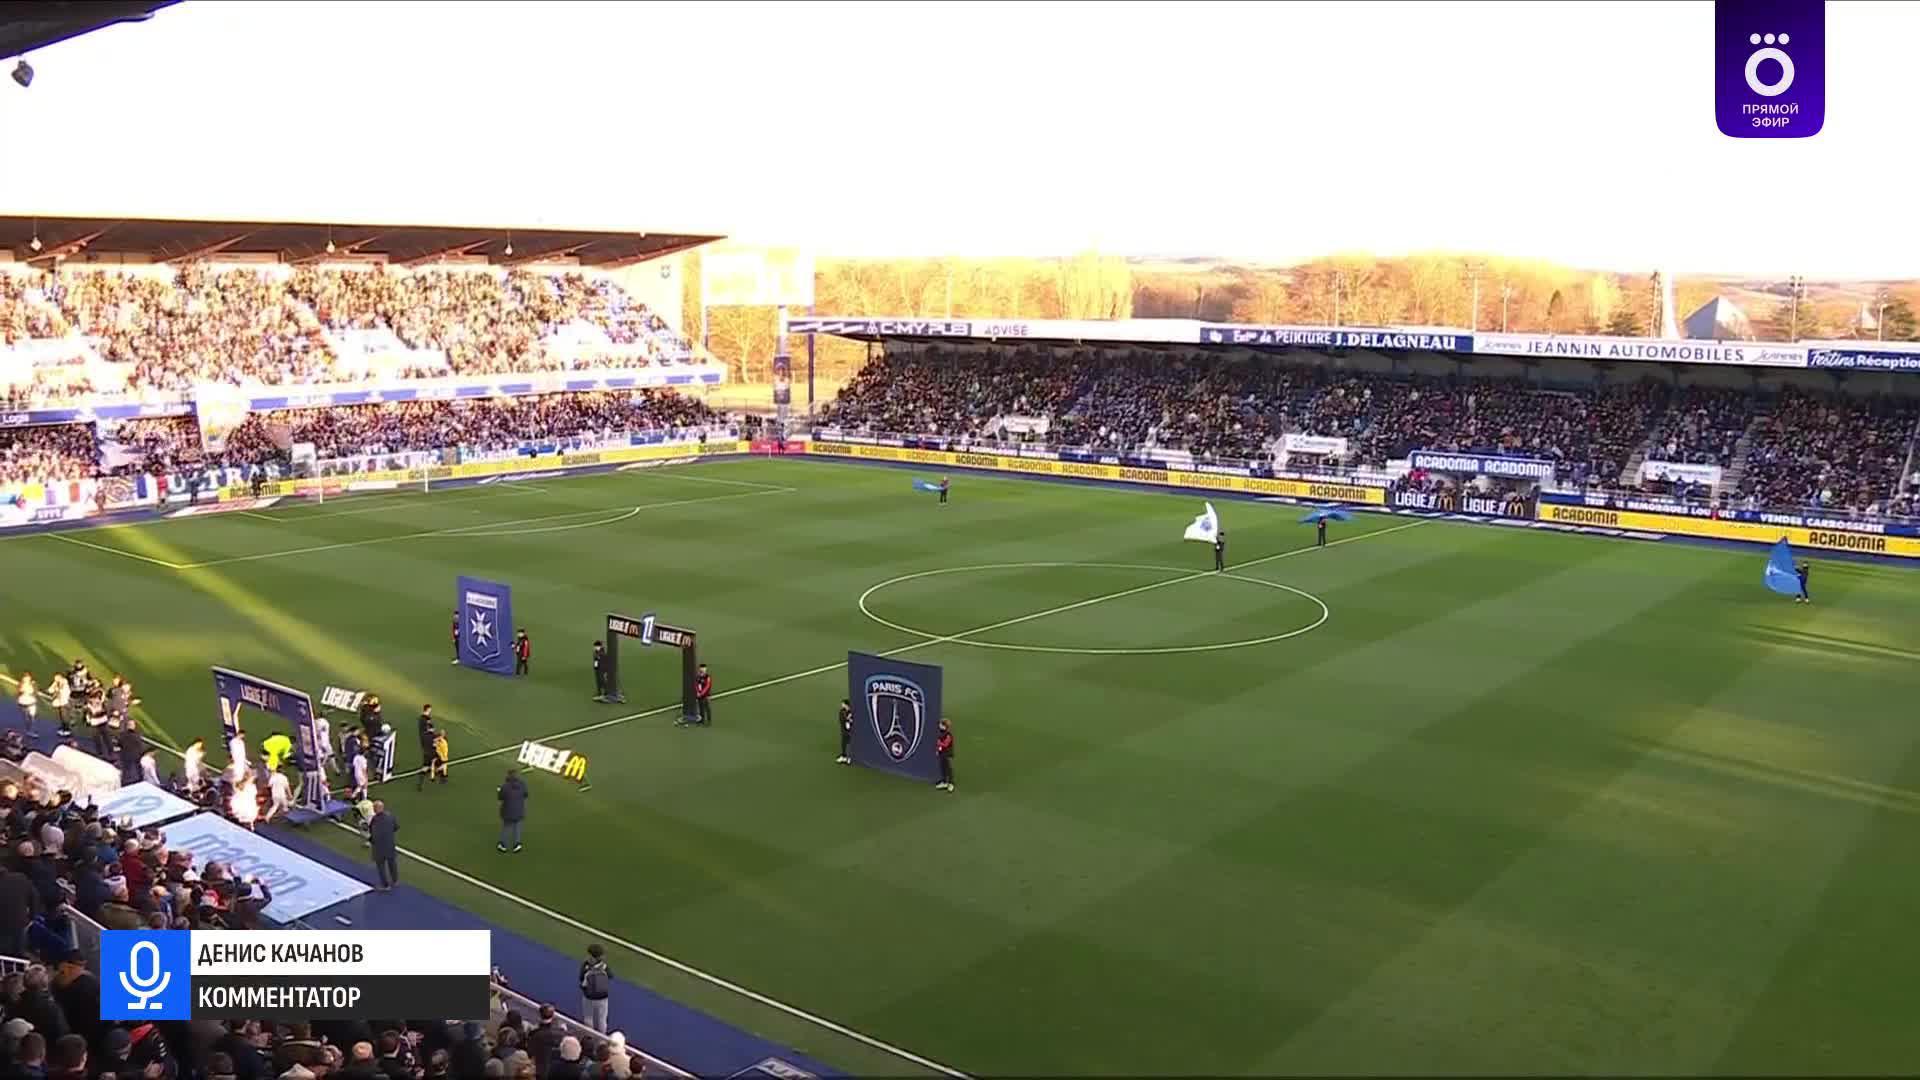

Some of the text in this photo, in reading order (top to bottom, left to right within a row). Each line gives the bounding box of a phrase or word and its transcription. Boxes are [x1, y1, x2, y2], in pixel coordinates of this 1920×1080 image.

[984, 325, 1029, 336] ADVISE
[1275, 331, 1331, 344] PEINTURE
[1527, 341, 1744, 361] JEANNIN AUTOMOBILES
[1810, 350, 1854, 367] Festins
[1415, 455, 1552, 478] ACADOMIA ACADOMIA
[956, 455, 998, 467] ACADOMIA
[1119, 468, 1169, 483] ACADOMIA
[1309, 484, 1367, 501] ACADOMIA
[1395, 491, 1429, 509] LIGUE
[1462, 495, 1496, 515] LIGUE
[1553, 507, 1618, 525] ACADOMIA
[1690, 506, 1736, 519] LOUULT
[1809, 532, 1886, 552] ACADOMIA
[872, 681, 919, 701] PARIS FC
[179, 833, 308, 897] macron
